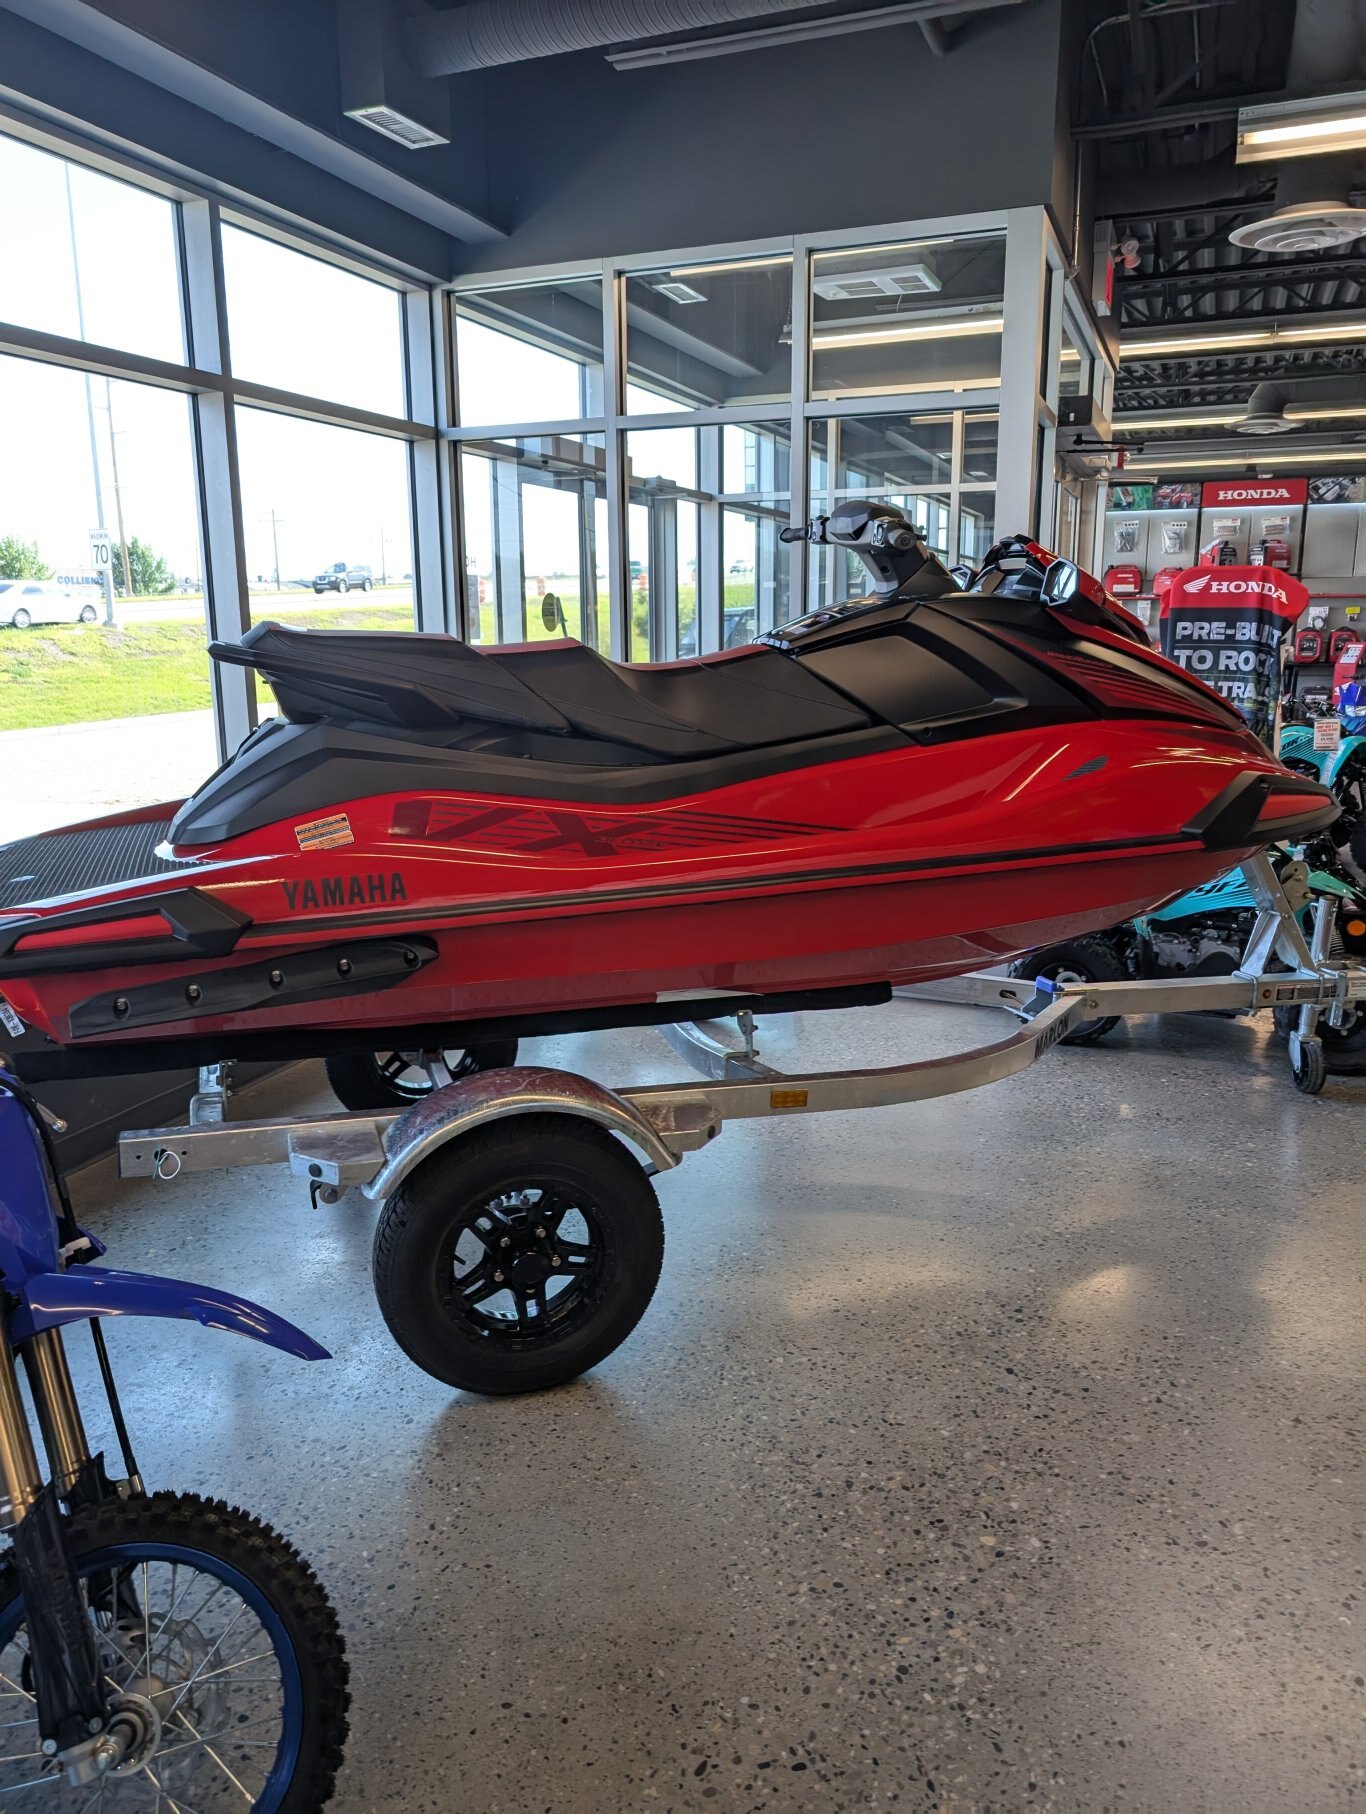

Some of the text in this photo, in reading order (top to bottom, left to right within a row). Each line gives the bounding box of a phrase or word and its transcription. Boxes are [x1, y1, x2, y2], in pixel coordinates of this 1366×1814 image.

[1217, 488, 1291, 500] HONDA
[92, 544, 109, 564] 70
[1209, 581, 1288, 604] HONDA
[1173, 649, 1214, 671] TO
[281, 872, 408, 910] YAMAHA
[1034, 1013, 1070, 1059] MARLON
